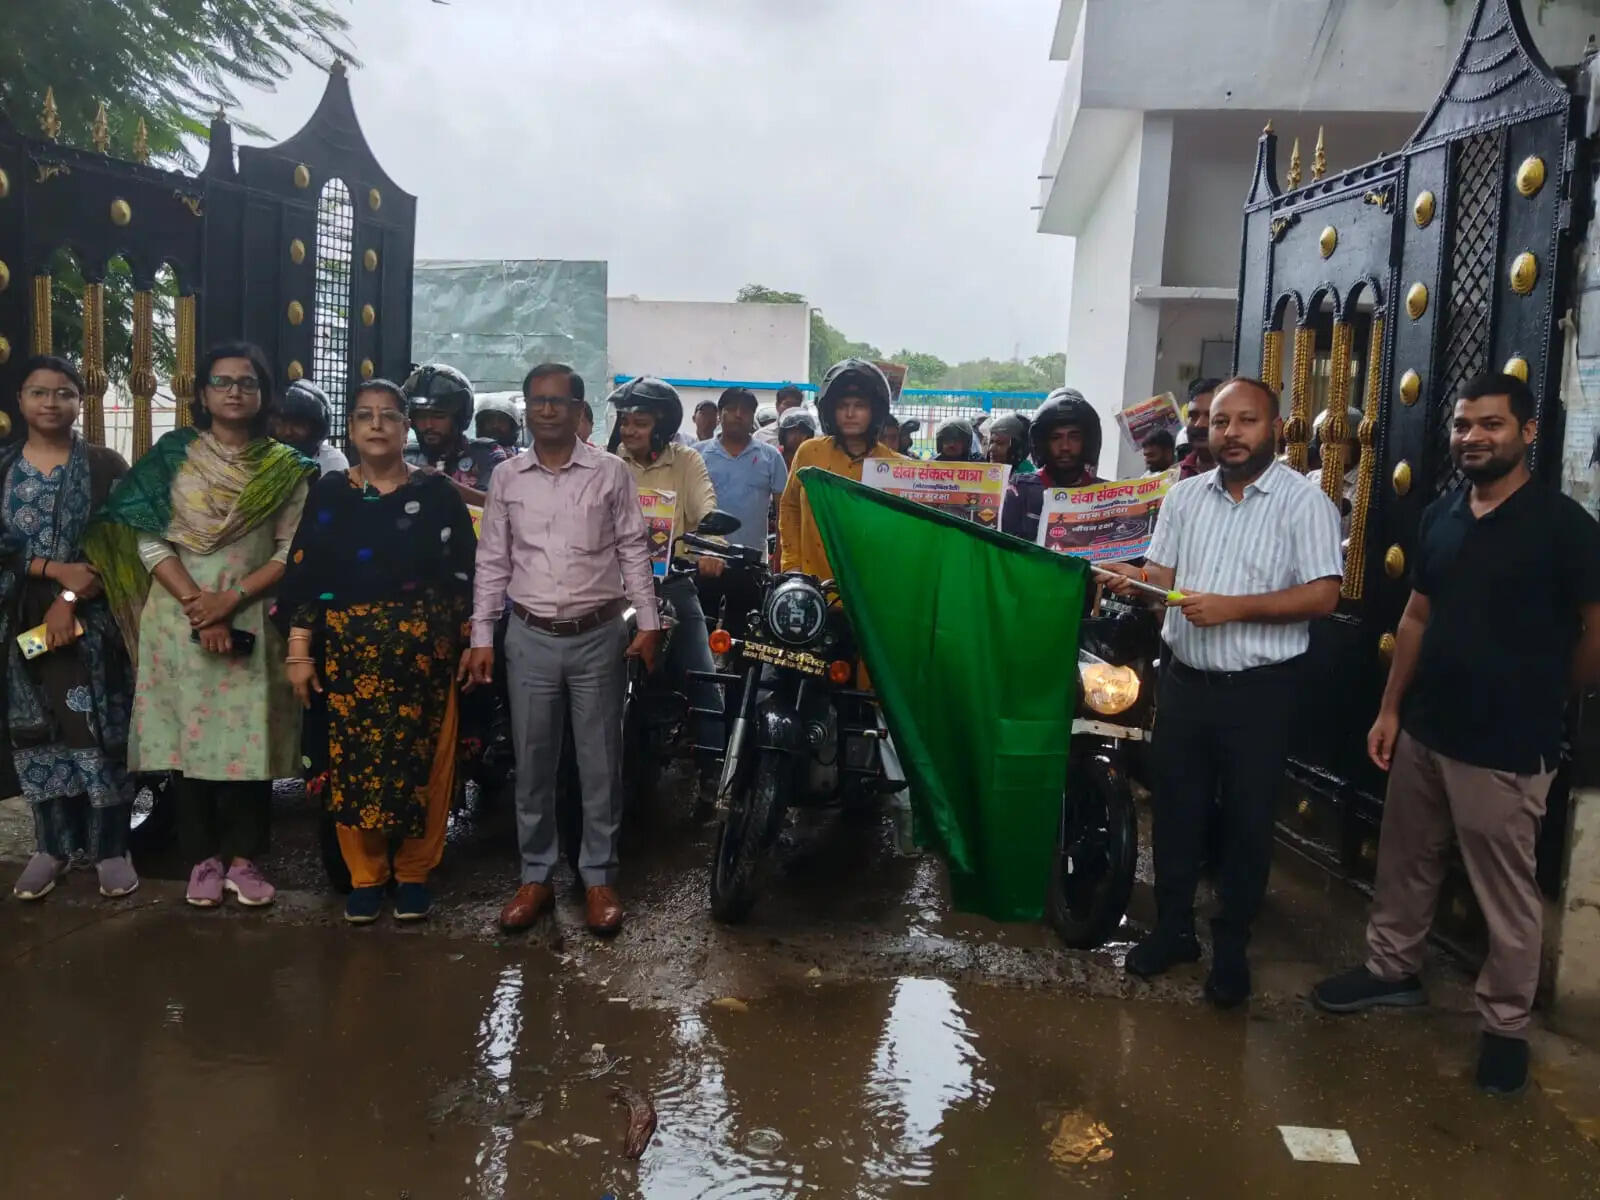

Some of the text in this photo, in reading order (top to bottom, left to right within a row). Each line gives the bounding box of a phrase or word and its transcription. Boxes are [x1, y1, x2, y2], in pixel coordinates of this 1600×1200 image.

[892, 462, 983, 483] सेवा संकल्प यात्रा
[1071, 479, 1161, 504] सेवा संकल्प यात्रा
